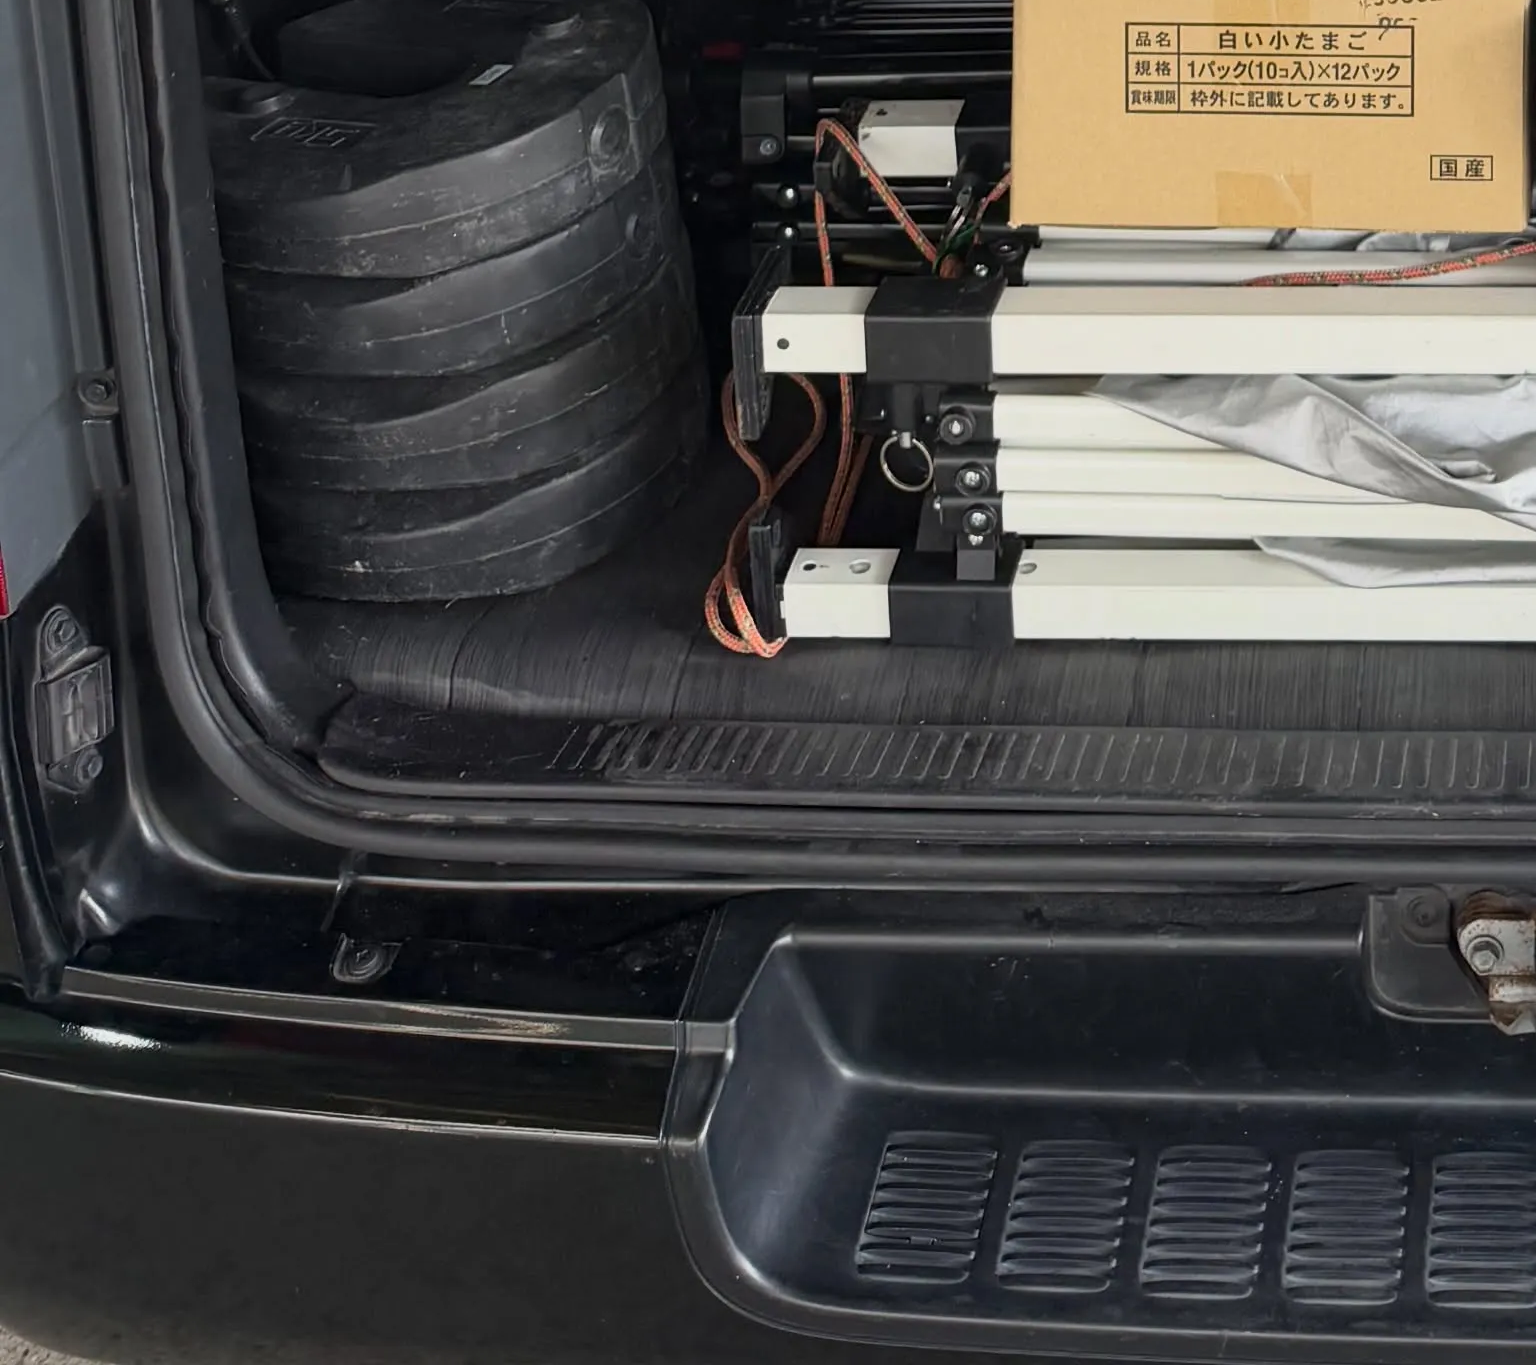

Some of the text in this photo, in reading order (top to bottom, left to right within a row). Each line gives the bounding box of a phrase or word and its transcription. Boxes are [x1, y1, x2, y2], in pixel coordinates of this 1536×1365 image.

[1135, 29, 1367, 51] 品名 白い小たまご
[1135, 59, 1172, 77] 規格
[1130, 89, 1405, 110] 賞味期限 枠外に記載してあります。
[1439, 158, 1485, 178] 国産
